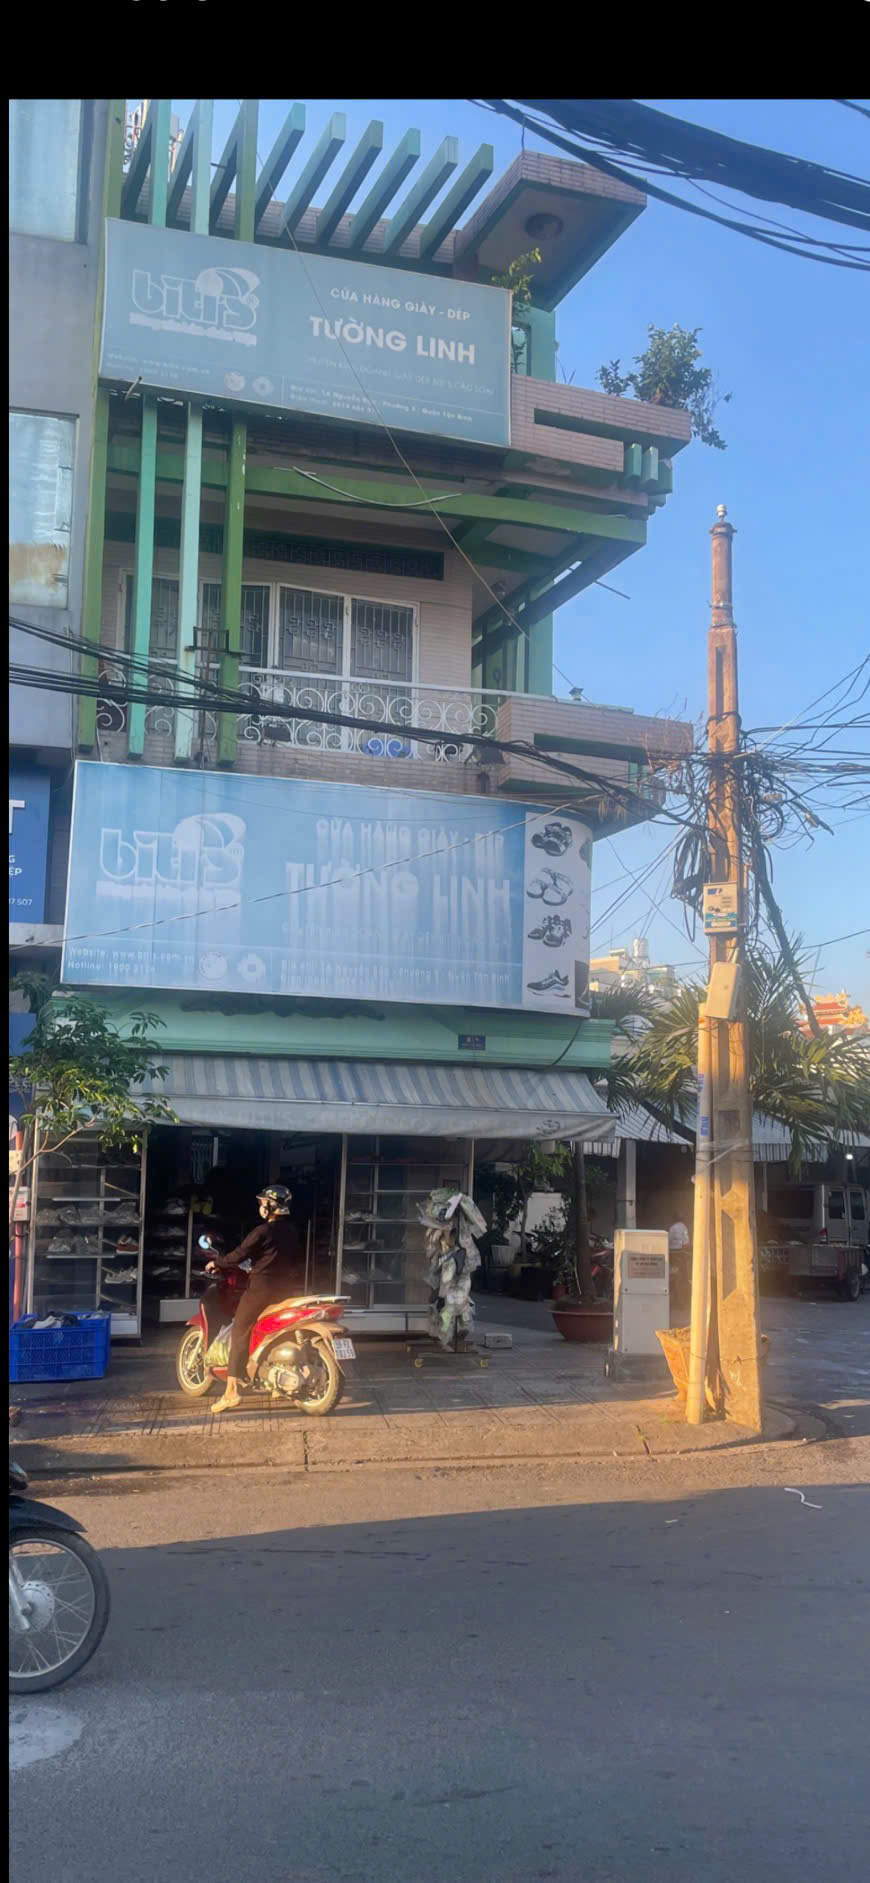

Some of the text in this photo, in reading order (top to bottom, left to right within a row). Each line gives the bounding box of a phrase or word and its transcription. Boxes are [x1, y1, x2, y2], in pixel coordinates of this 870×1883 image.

[330, 287, 358, 303] CỬA
[363, 292, 400, 309] HÀNG
[405, 299, 436, 316] GIÀY
[447, 307, 471, 321] DÉP
[309, 315, 475, 365] TƯỜNG LINH
